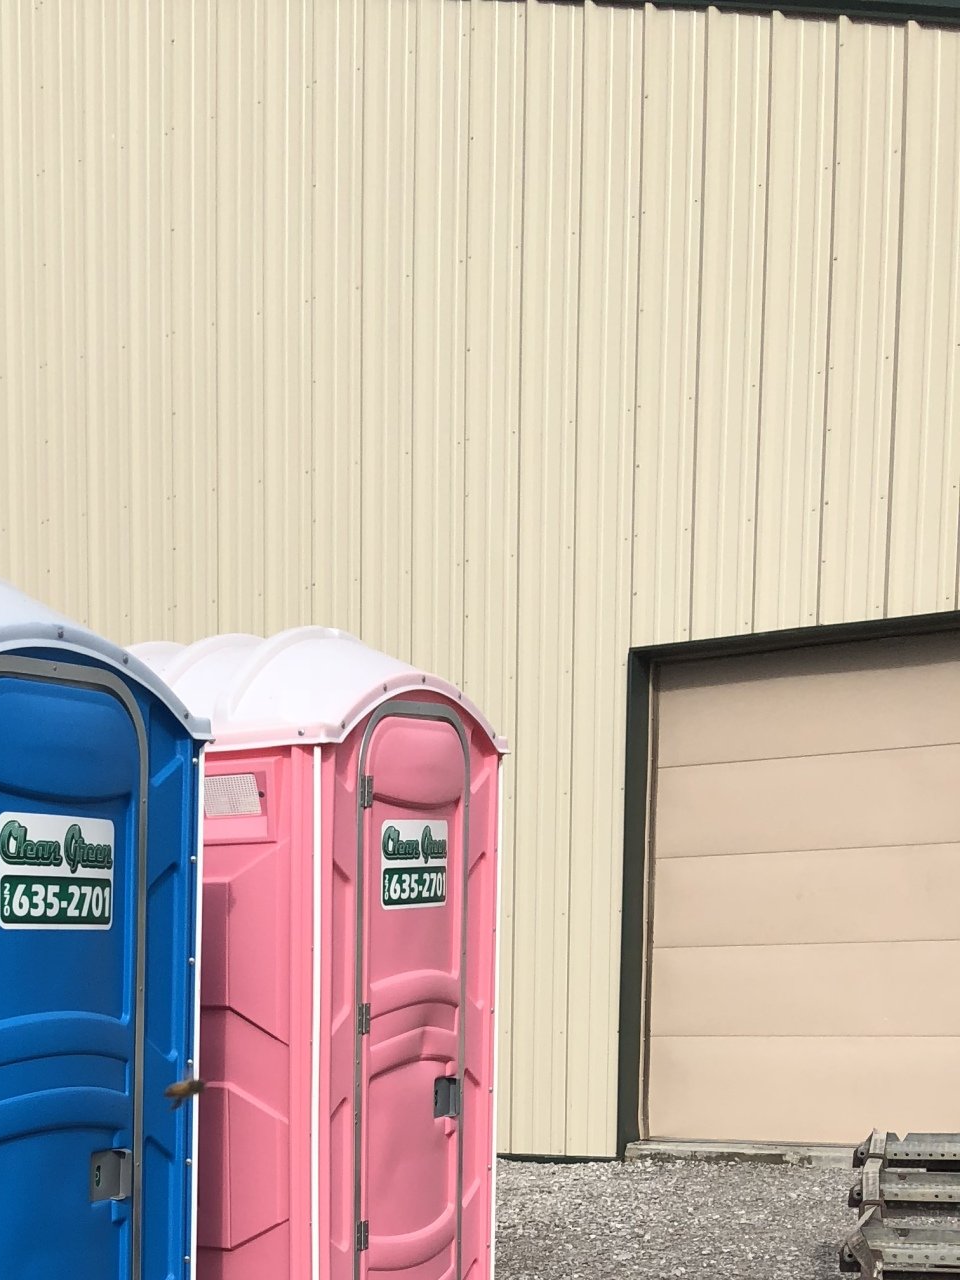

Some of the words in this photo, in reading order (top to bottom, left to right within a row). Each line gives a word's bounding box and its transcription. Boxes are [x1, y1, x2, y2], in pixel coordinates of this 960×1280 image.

[0, 820, 63, 867] Clean
[64, 824, 113, 874] Green
[382, 825, 420, 860] Clean
[12, 883, 110, 917] 635-2701
[389, 872, 446, 900] 635-2701
